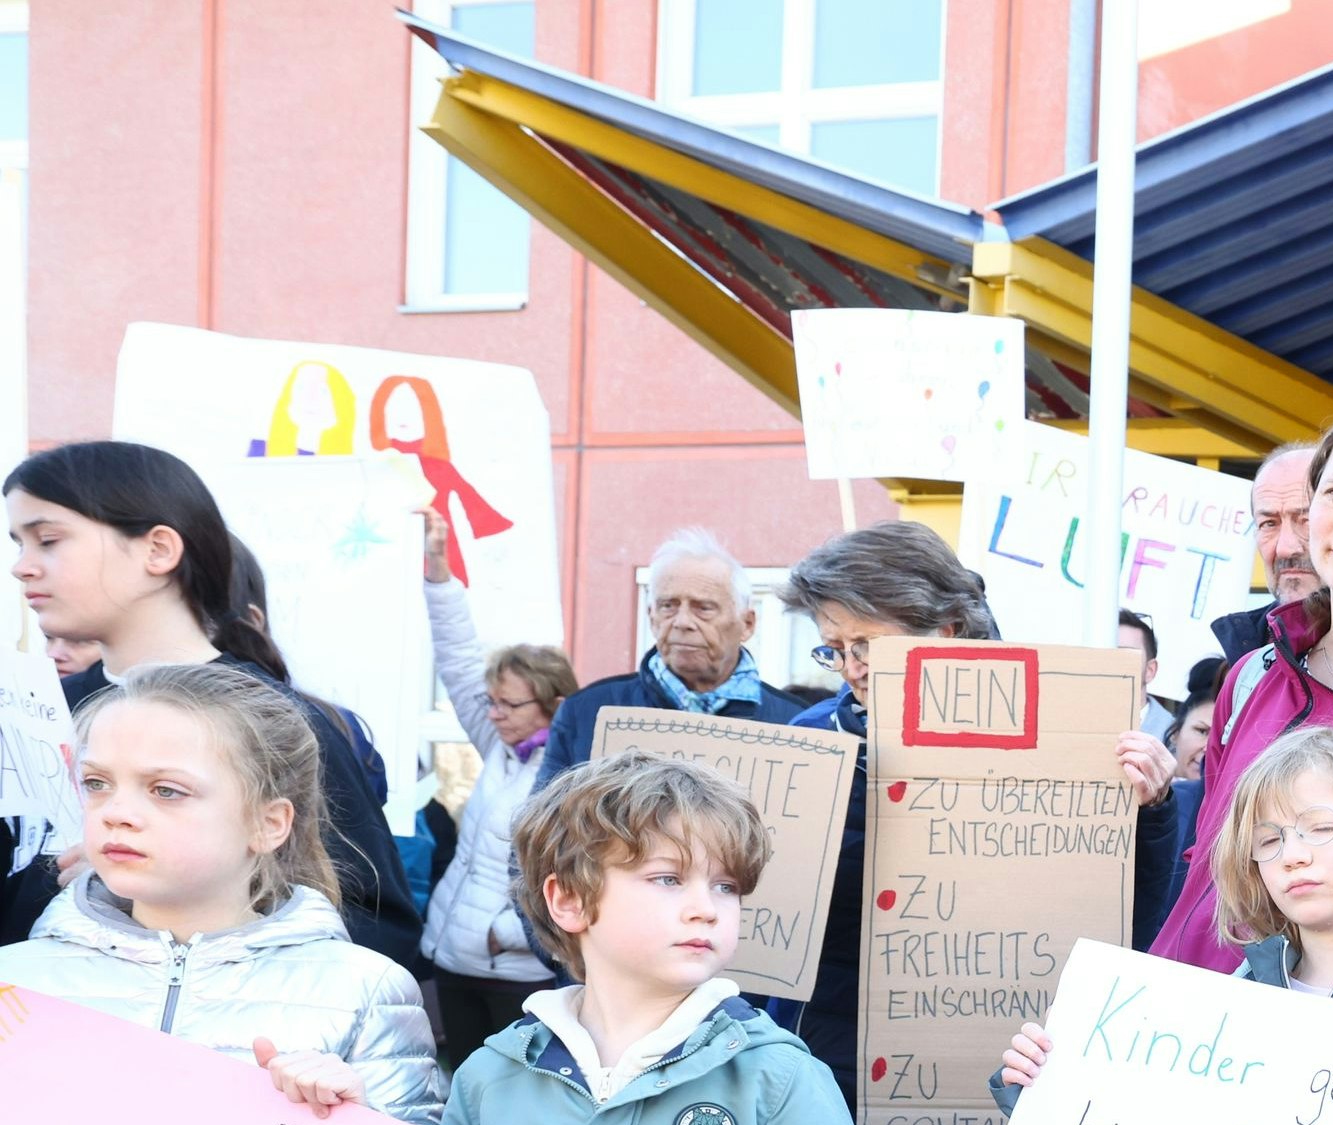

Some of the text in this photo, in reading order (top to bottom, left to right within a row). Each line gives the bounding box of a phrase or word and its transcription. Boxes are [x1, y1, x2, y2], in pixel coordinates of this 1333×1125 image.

[1024, 452, 1257, 536] IR RAUCHE
[921, 665, 1018, 728] NEIN
[908, 768, 1135, 819] ZU ÜBEREILTEN
[928, 817, 1132, 859] ENTSCHEIDUNGEN
[898, 874, 957, 921] ZU
[875, 930, 1057, 981] FREIHEITS
[1082, 975, 1266, 1085] Kinder
[888, 1054, 938, 1101] ZU
